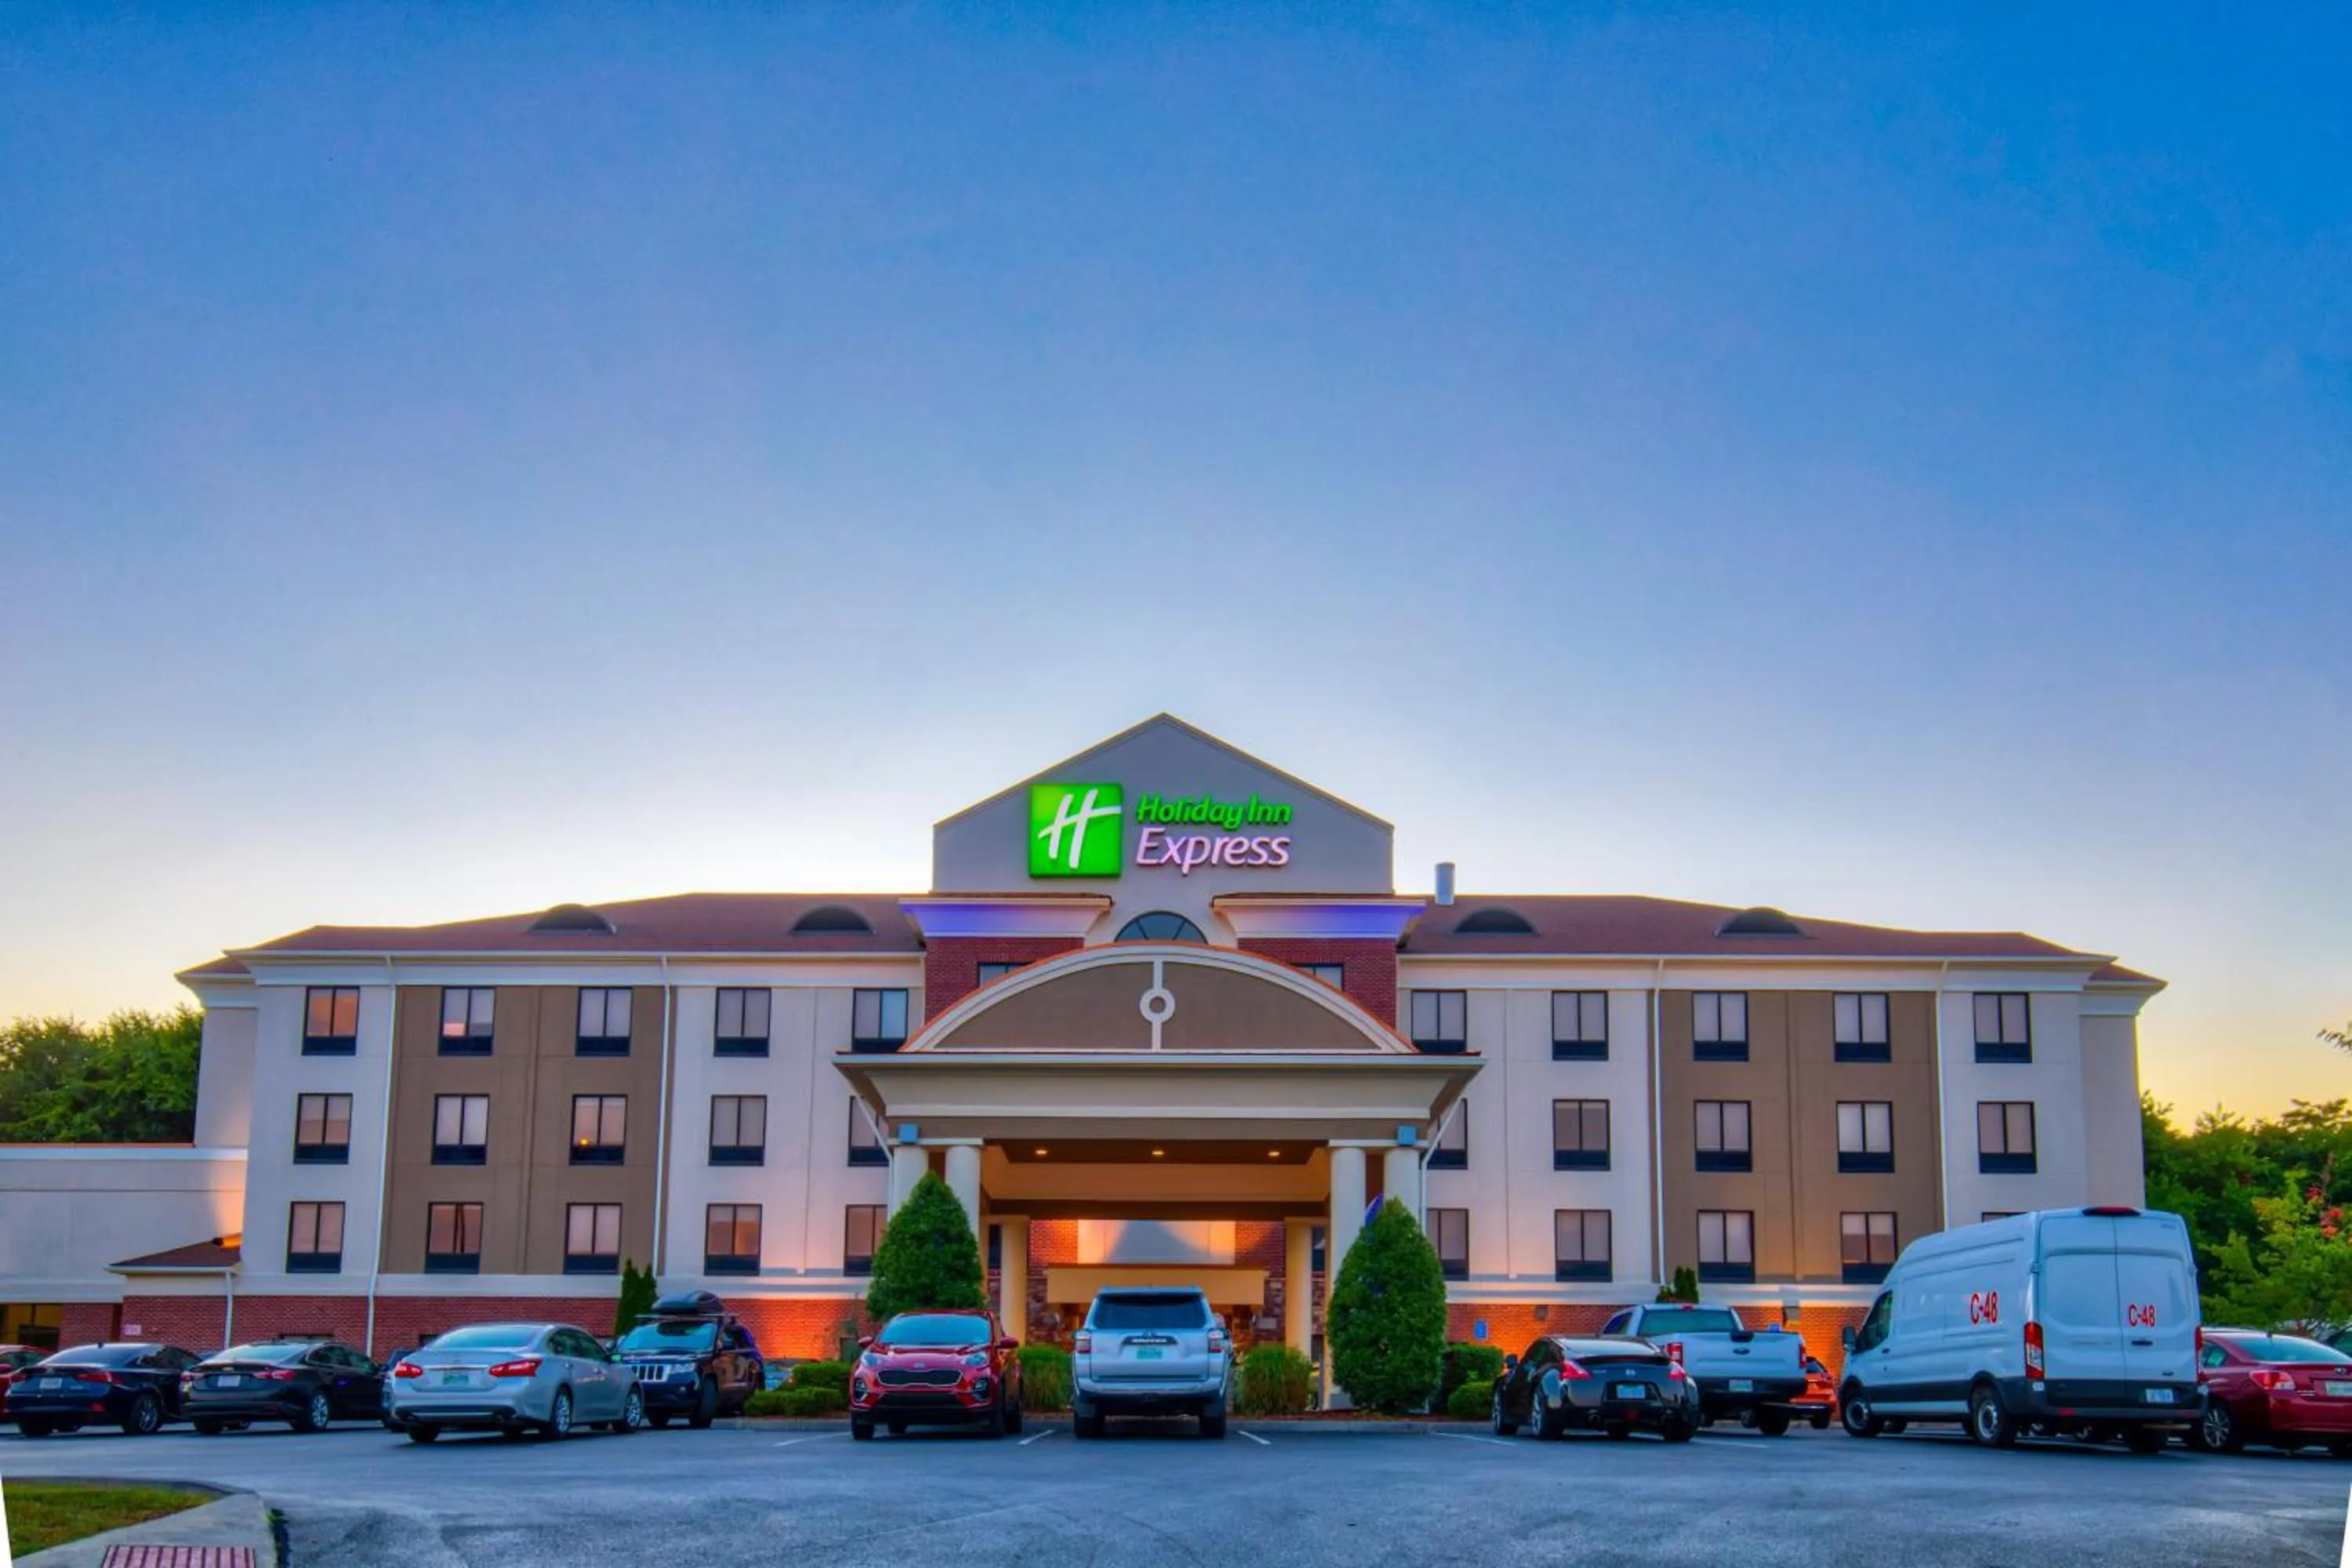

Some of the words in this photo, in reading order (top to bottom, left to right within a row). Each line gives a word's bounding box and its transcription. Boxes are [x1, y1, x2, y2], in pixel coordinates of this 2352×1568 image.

[1138, 795, 1243, 829] Holiday
[1247, 795, 1291, 823] Inn
[1137, 827, 1290, 875] Express
[1970, 1291, 1998, 1325] C-48
[2129, 1303, 2155, 1327] C-48
